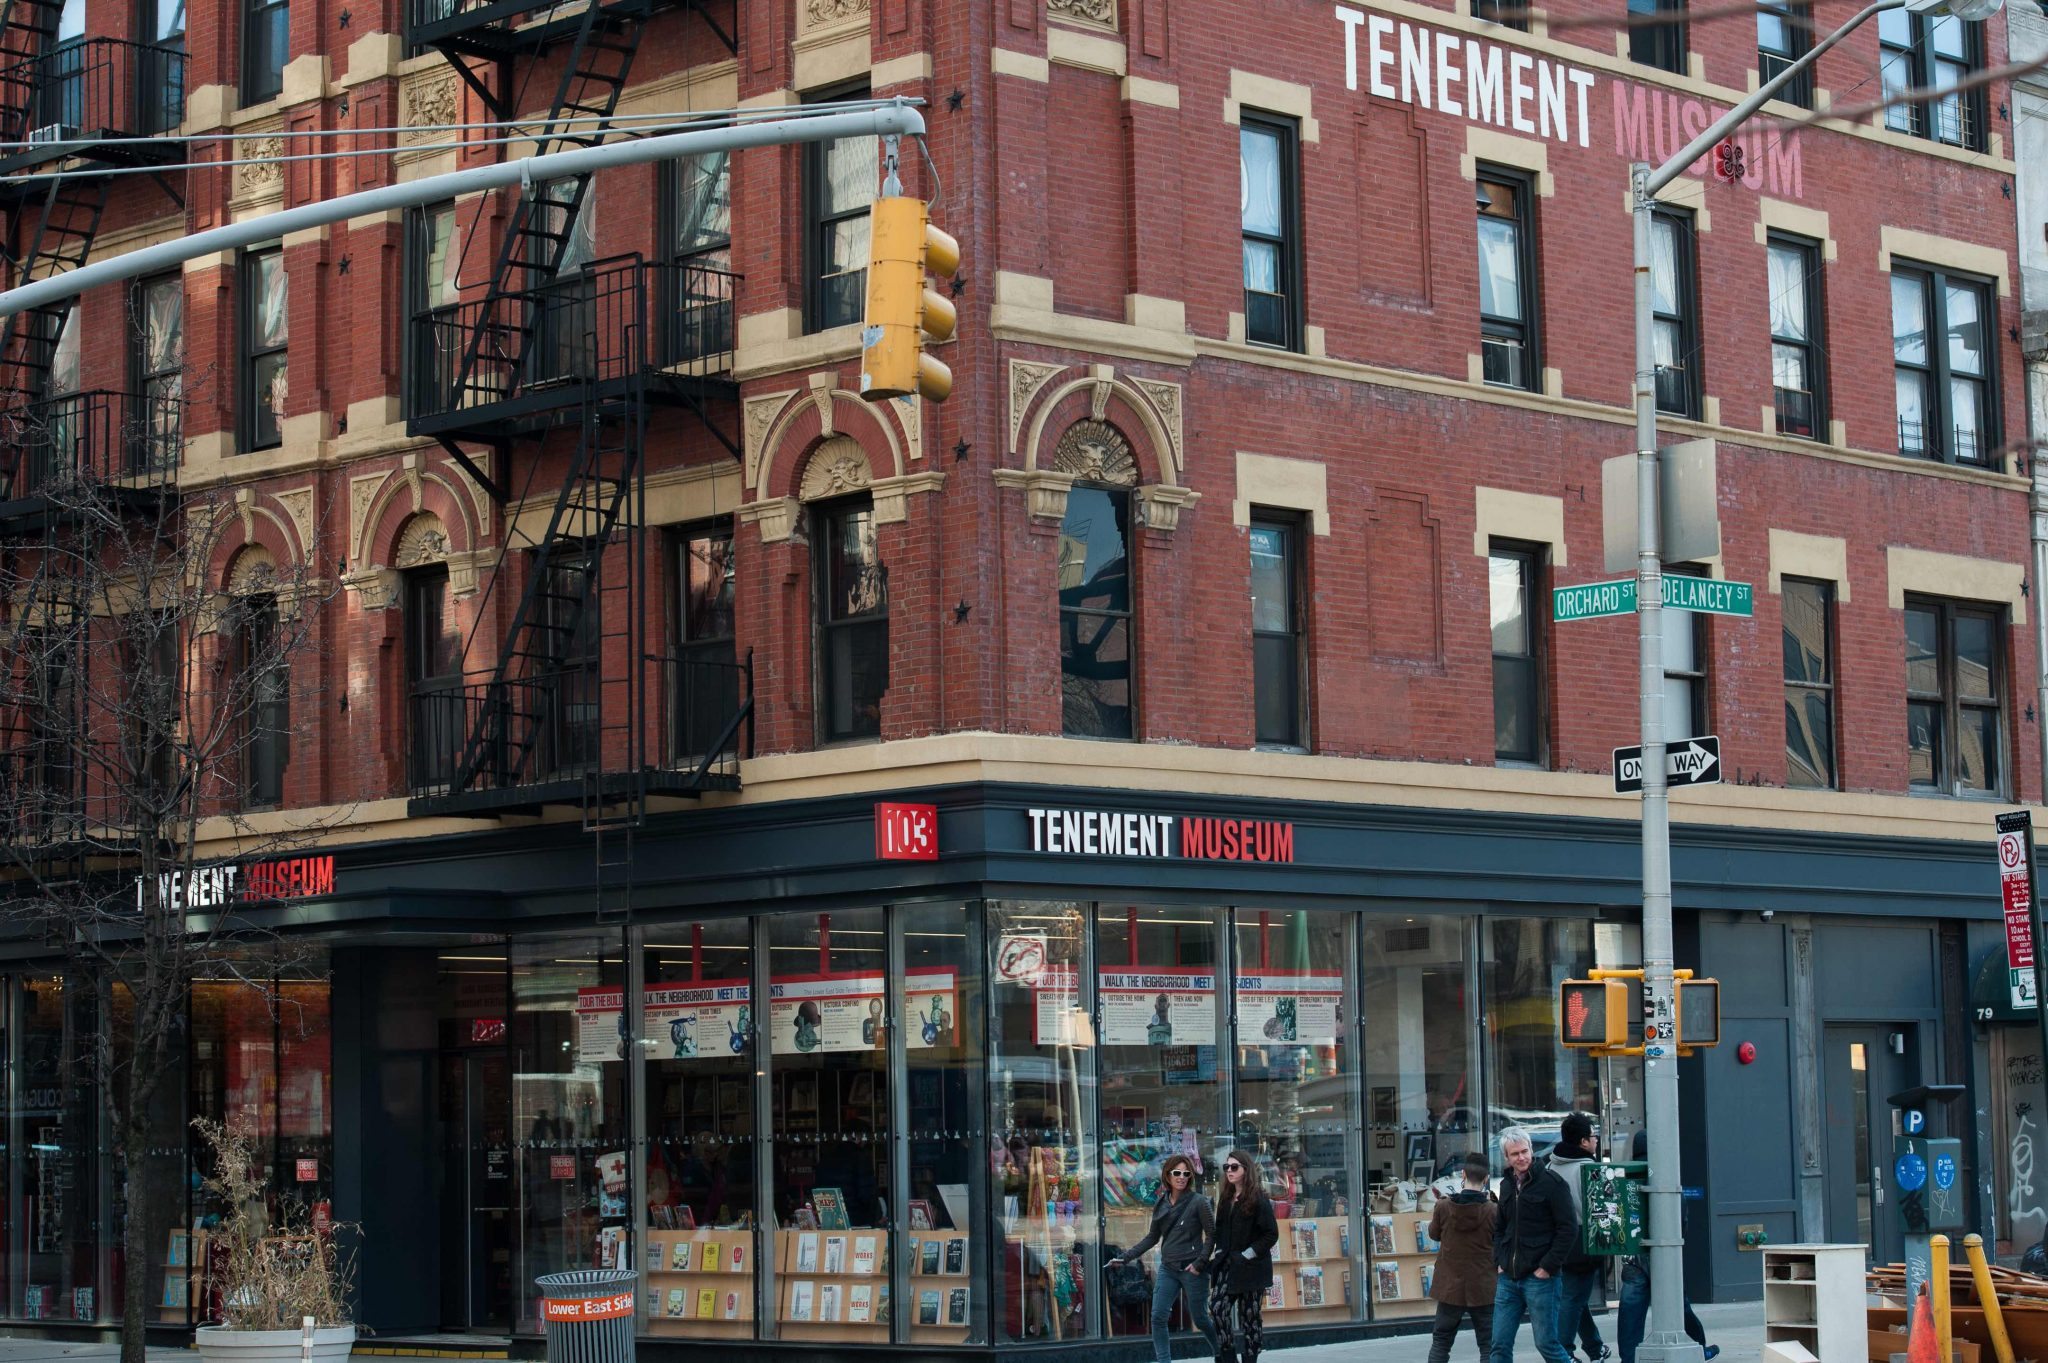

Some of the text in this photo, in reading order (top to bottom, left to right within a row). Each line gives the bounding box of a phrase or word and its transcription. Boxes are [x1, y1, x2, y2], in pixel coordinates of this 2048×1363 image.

[1336, 6, 1594, 148] TENEMENT
[1557, 584, 1634, 617] ORCHARD ST
[1663, 579, 1749, 610] DELANCEY ST
[1623, 753, 1707, 779] ON WAY
[887, 810, 929, 853] 103
[1028, 808, 1294, 864] TENEMENT MUSEUM
[134, 855, 335, 912] TNEMENT MUSEUM
[2004, 873, 2011, 882] NO
[2008, 914, 2029, 924] NO STAN
[2011, 924, 2031, 934] 10AM-4
[2011, 934, 2027, 942] SCHOOL
[1104, 975, 1124, 987] WALK
[1126, 975, 1140, 987] THE
[1141, 976, 1190, 988] NEIGHBORHOOD
[1194, 976, 1211, 988] MEET
[1236, 977, 1262, 989] SIDENTS
[579, 996, 594, 1008] TOUR
[595, 995, 606, 1007] THE
[607, 994, 623, 1007] BUILD
[656, 992, 667, 1003] THE
[669, 989, 713, 1003] NEIGHBORHOOD
[717, 988, 733, 1000] MEET
[737, 987, 747, 999] THE
[1977, 1007, 1994, 1020] 79
[1909, 1110, 1922, 1132] P
[606, 1182, 626, 1193] SUPP
[548, 1293, 632, 1315] Lower East Side
